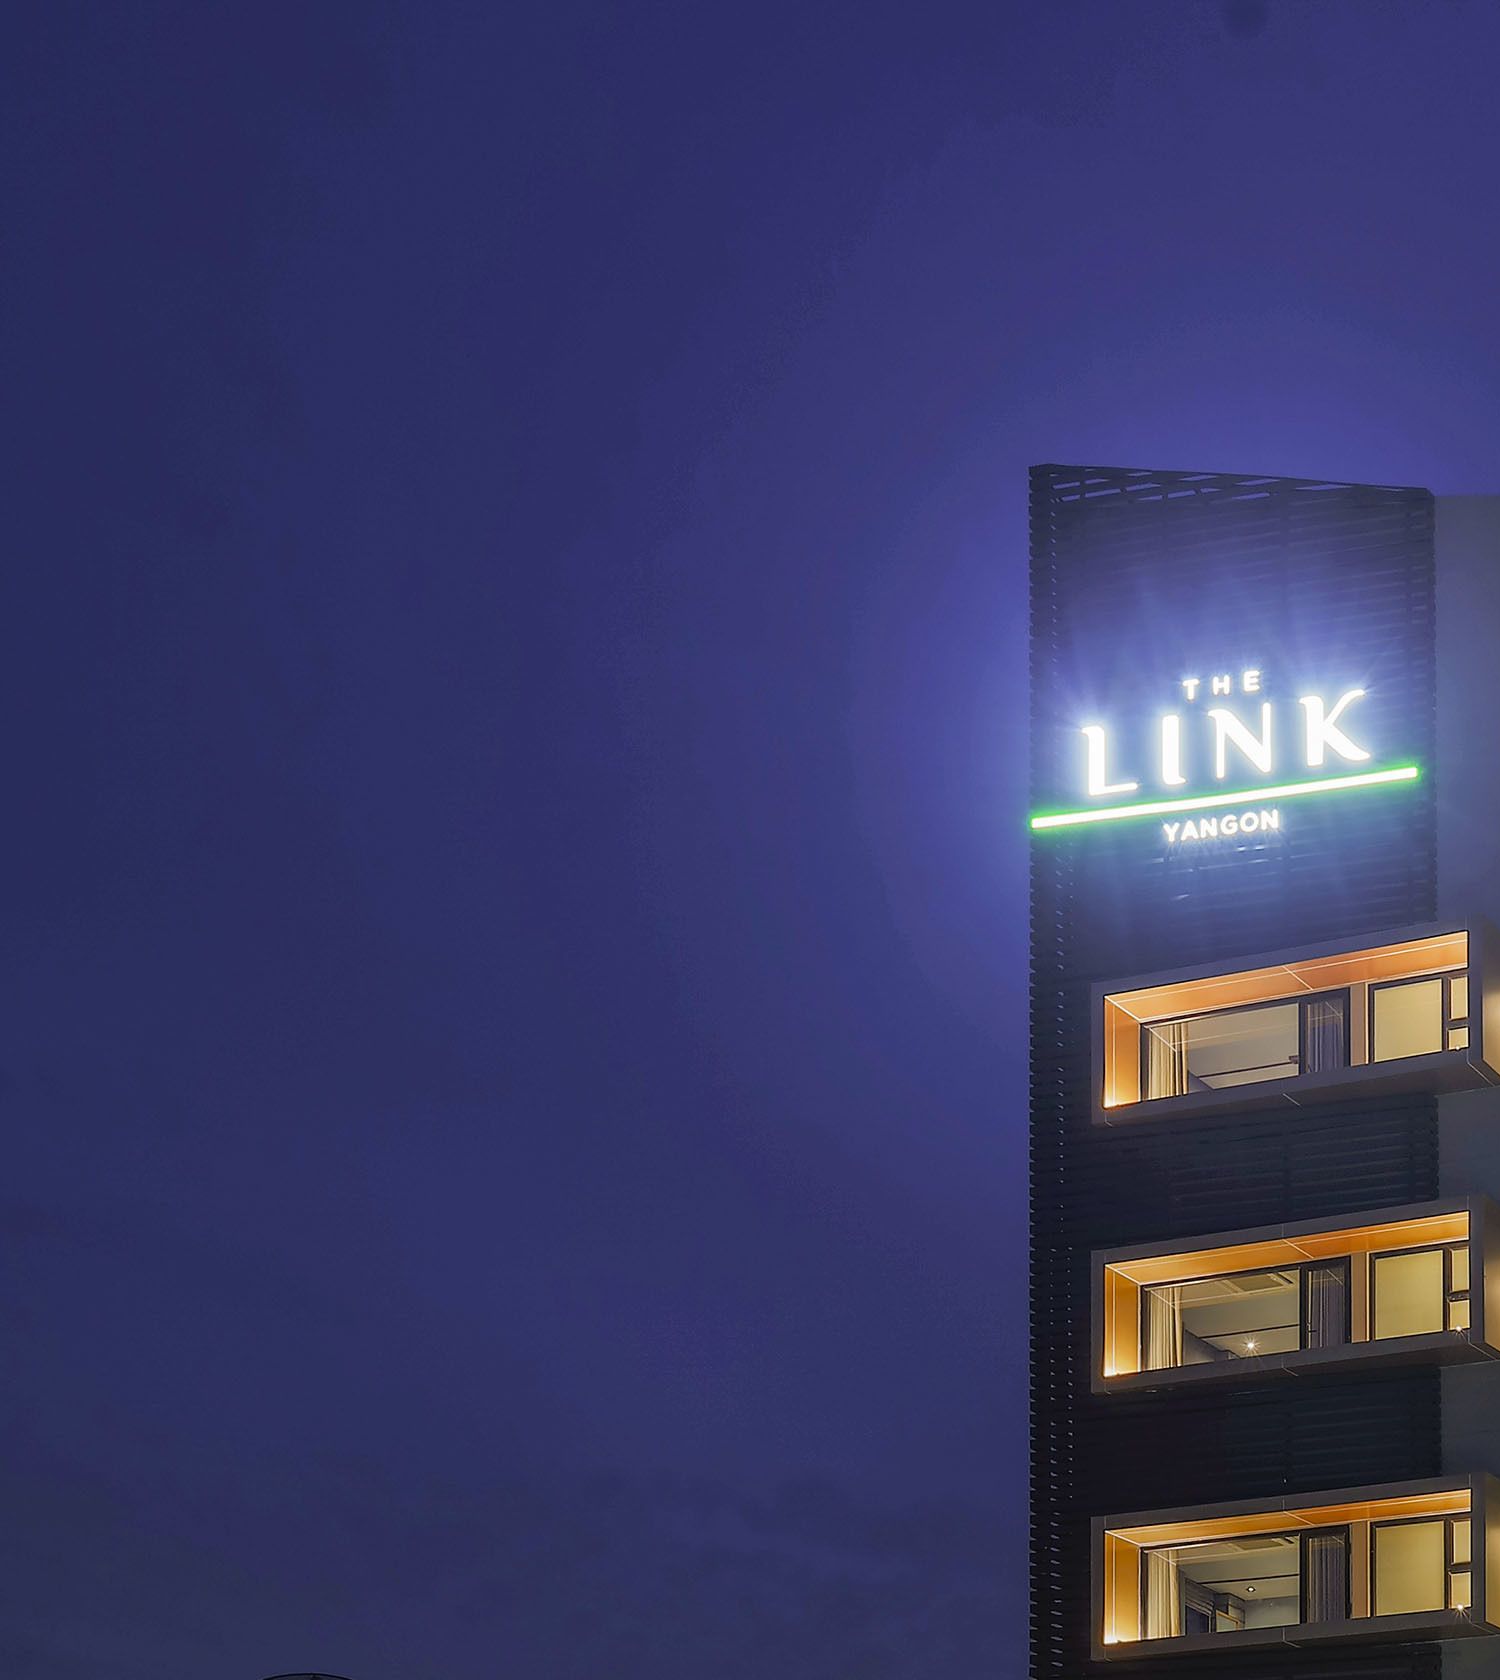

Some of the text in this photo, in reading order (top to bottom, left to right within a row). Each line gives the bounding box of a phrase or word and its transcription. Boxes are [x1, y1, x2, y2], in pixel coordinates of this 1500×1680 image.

[1182, 670, 1260, 700] THE
[1081, 689, 1371, 796] LINK
[1163, 809, 1280, 842] YANGON
